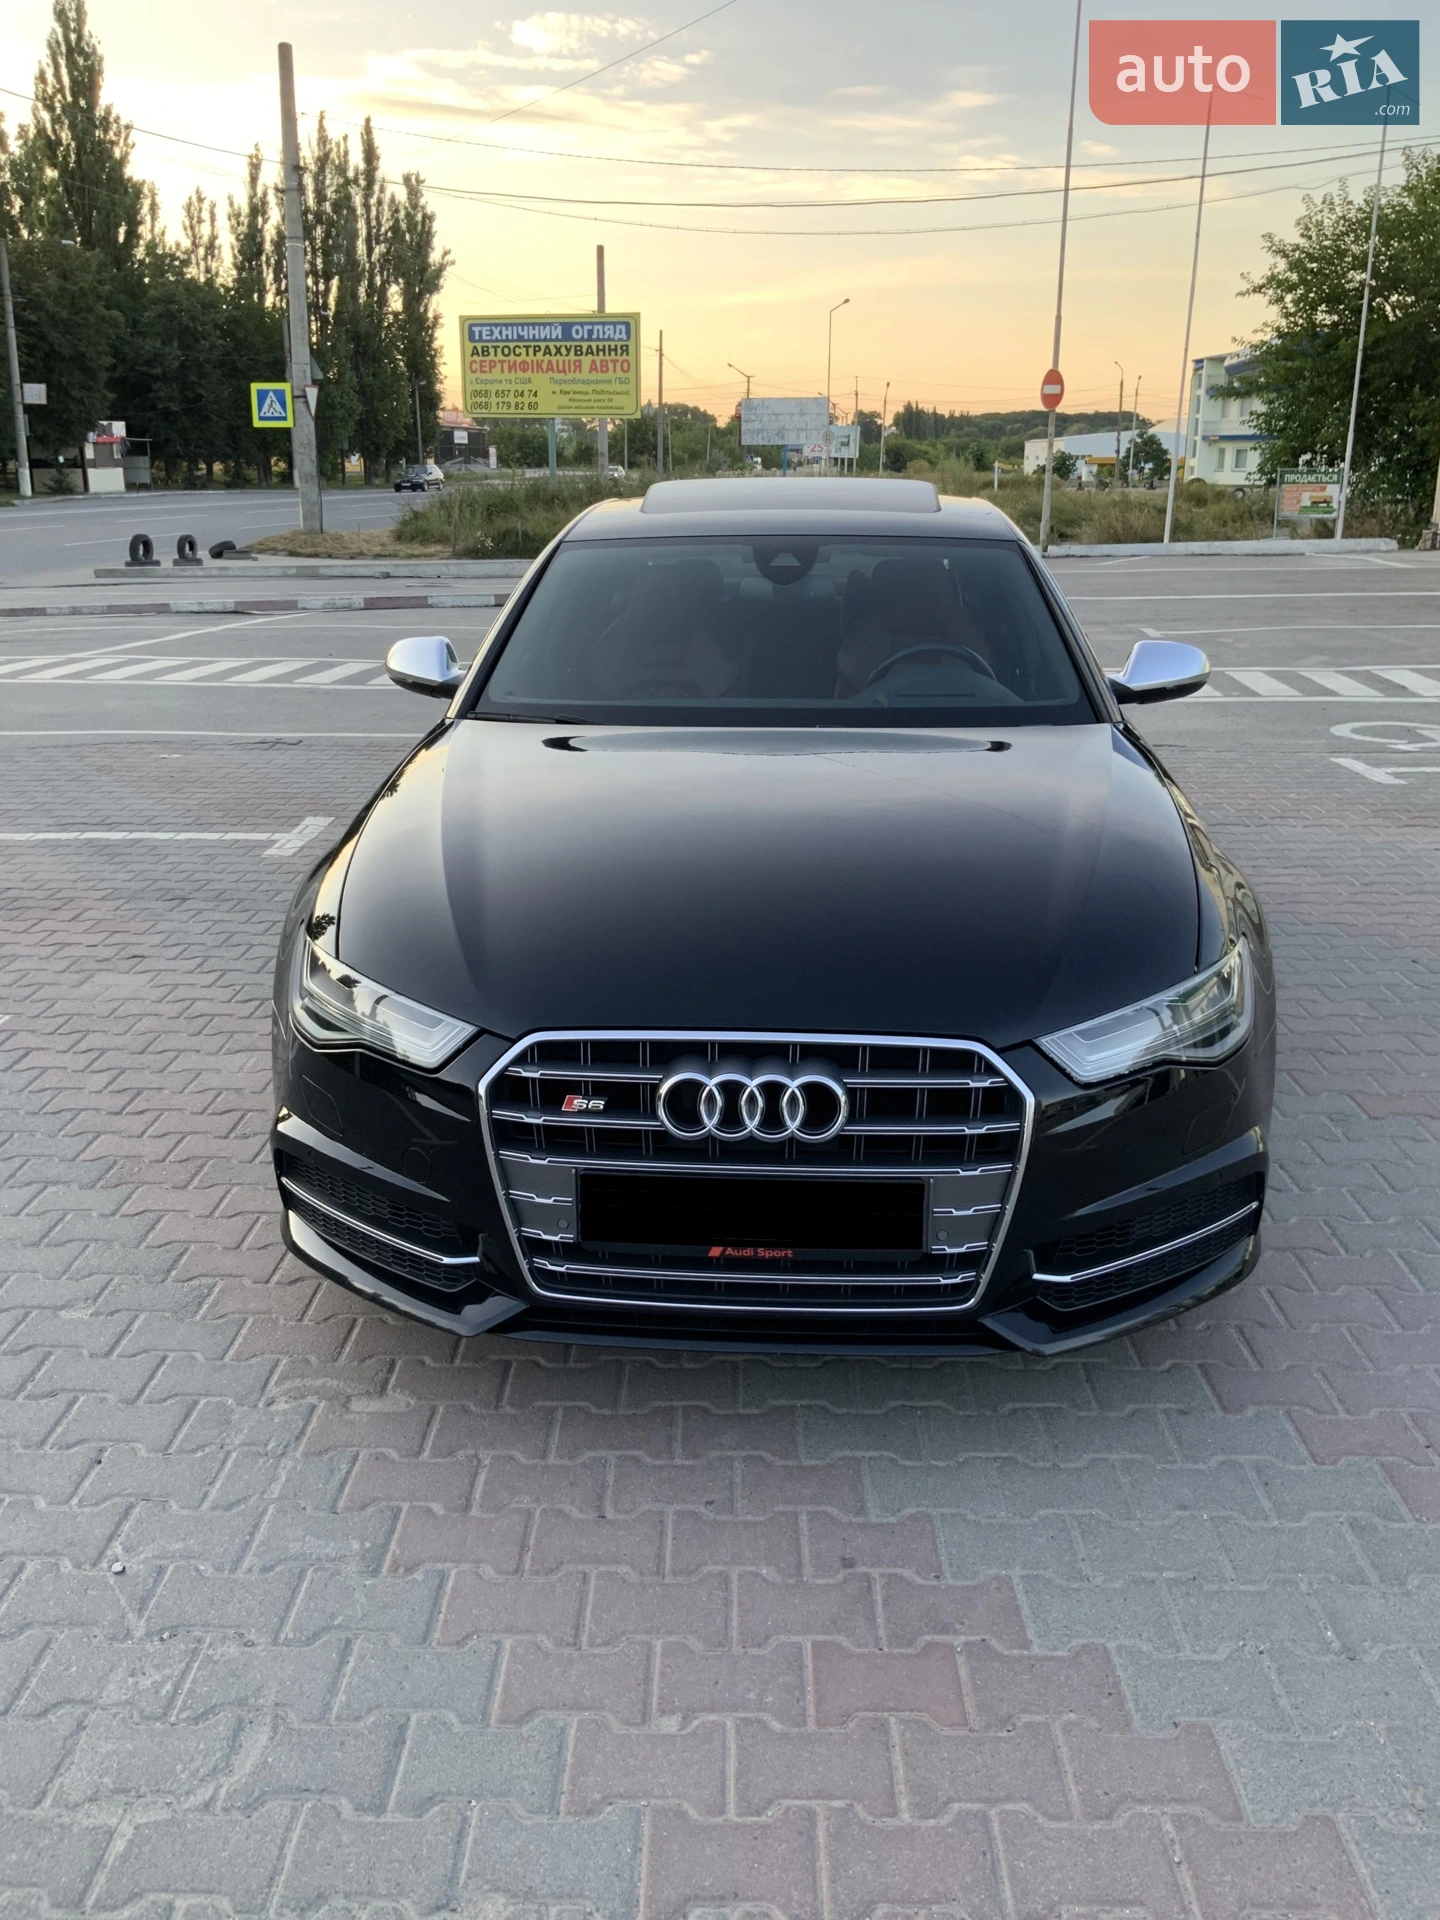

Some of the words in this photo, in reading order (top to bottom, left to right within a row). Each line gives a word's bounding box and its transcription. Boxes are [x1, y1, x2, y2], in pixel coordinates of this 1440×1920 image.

[472, 323, 562, 340] ТЕХНІЧНИЙ
[571, 325, 627, 340] ОГЛЯД
[470, 344, 630, 357] АВТОСТРАХУВАННЯ
[469, 359, 582, 375] СЕРТИФІКАЦІЯ
[588, 359, 631, 374] АВТО
[475, 377, 503, 385] Європи
[514, 377, 532, 385] США
[549, 377, 612, 386] Переобладнання
[614, 377, 630, 385] ГБО
[470, 389, 492, 400] (068)
[495, 390, 511, 398] 657
[513, 390, 525, 398] 04
[527, 390, 538, 398] 74
[471, 401, 492, 412] (068)
[496, 402, 511, 410] 179
[514, 402, 525, 410] 82
[527, 402, 539, 410] 60
[1284, 474, 1338, 484] ПРОДАЄТЬСЯ
[572, 1099, 605, 1110] S6
[725, 1247, 754, 1256] Audi
[757, 1248, 793, 1258] Sport
